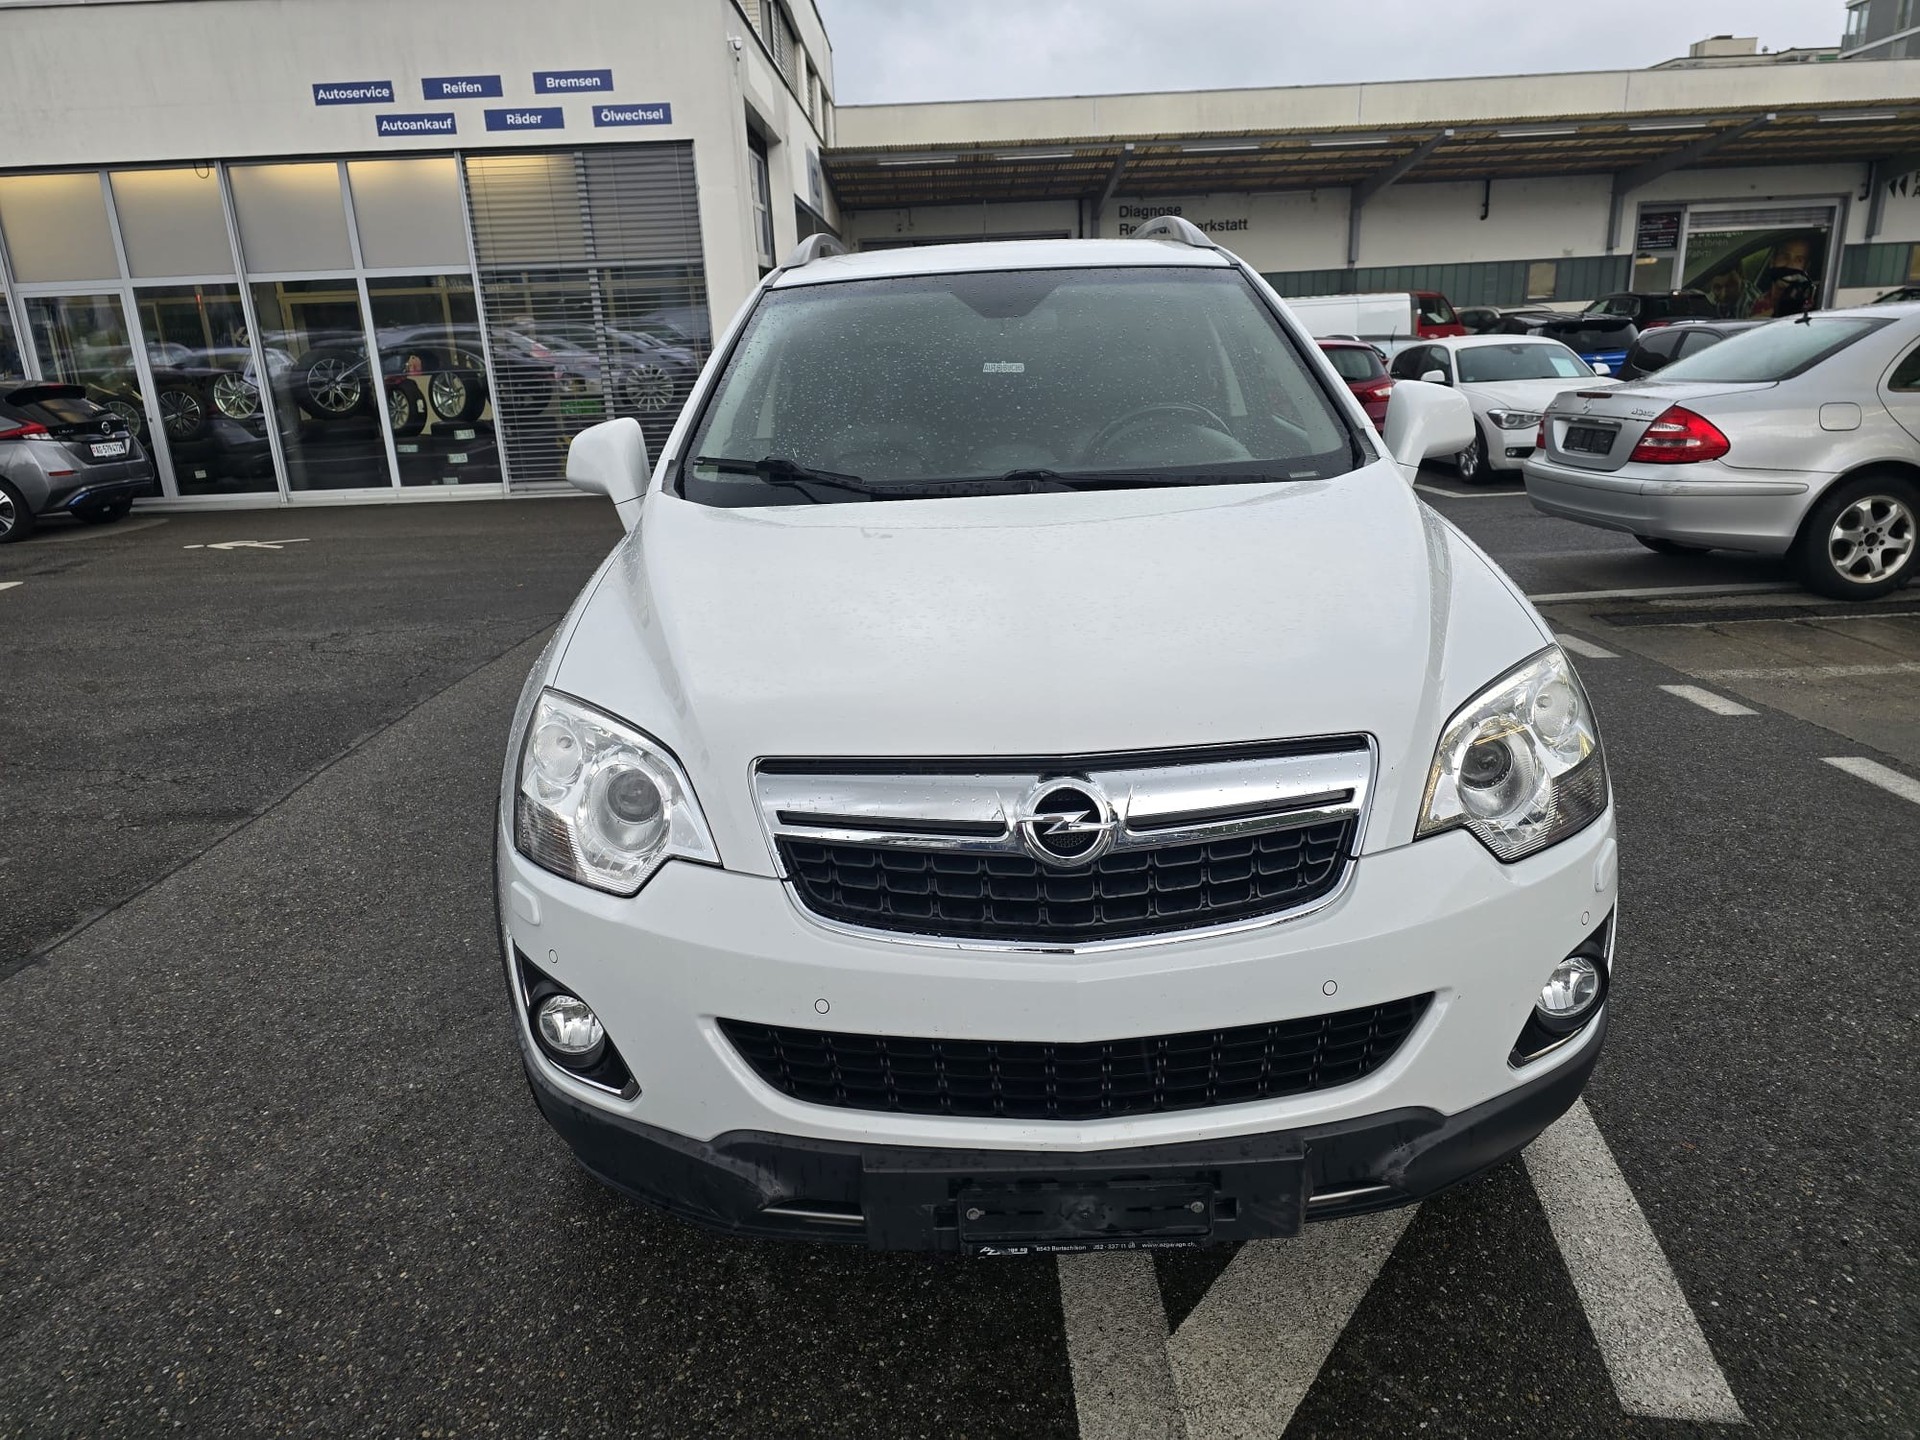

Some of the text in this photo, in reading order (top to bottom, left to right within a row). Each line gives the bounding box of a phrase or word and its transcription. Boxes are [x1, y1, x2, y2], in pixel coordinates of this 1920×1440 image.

[442, 81, 482, 94] Reifen
[545, 75, 601, 89] Bremsen
[317, 86, 390, 101] Autoservice
[506, 112, 543, 125] Räder
[600, 107, 664, 122] Ölwechsel
[381, 118, 452, 132] Autoankauf
[1119, 205, 1182, 219] Diagnose
